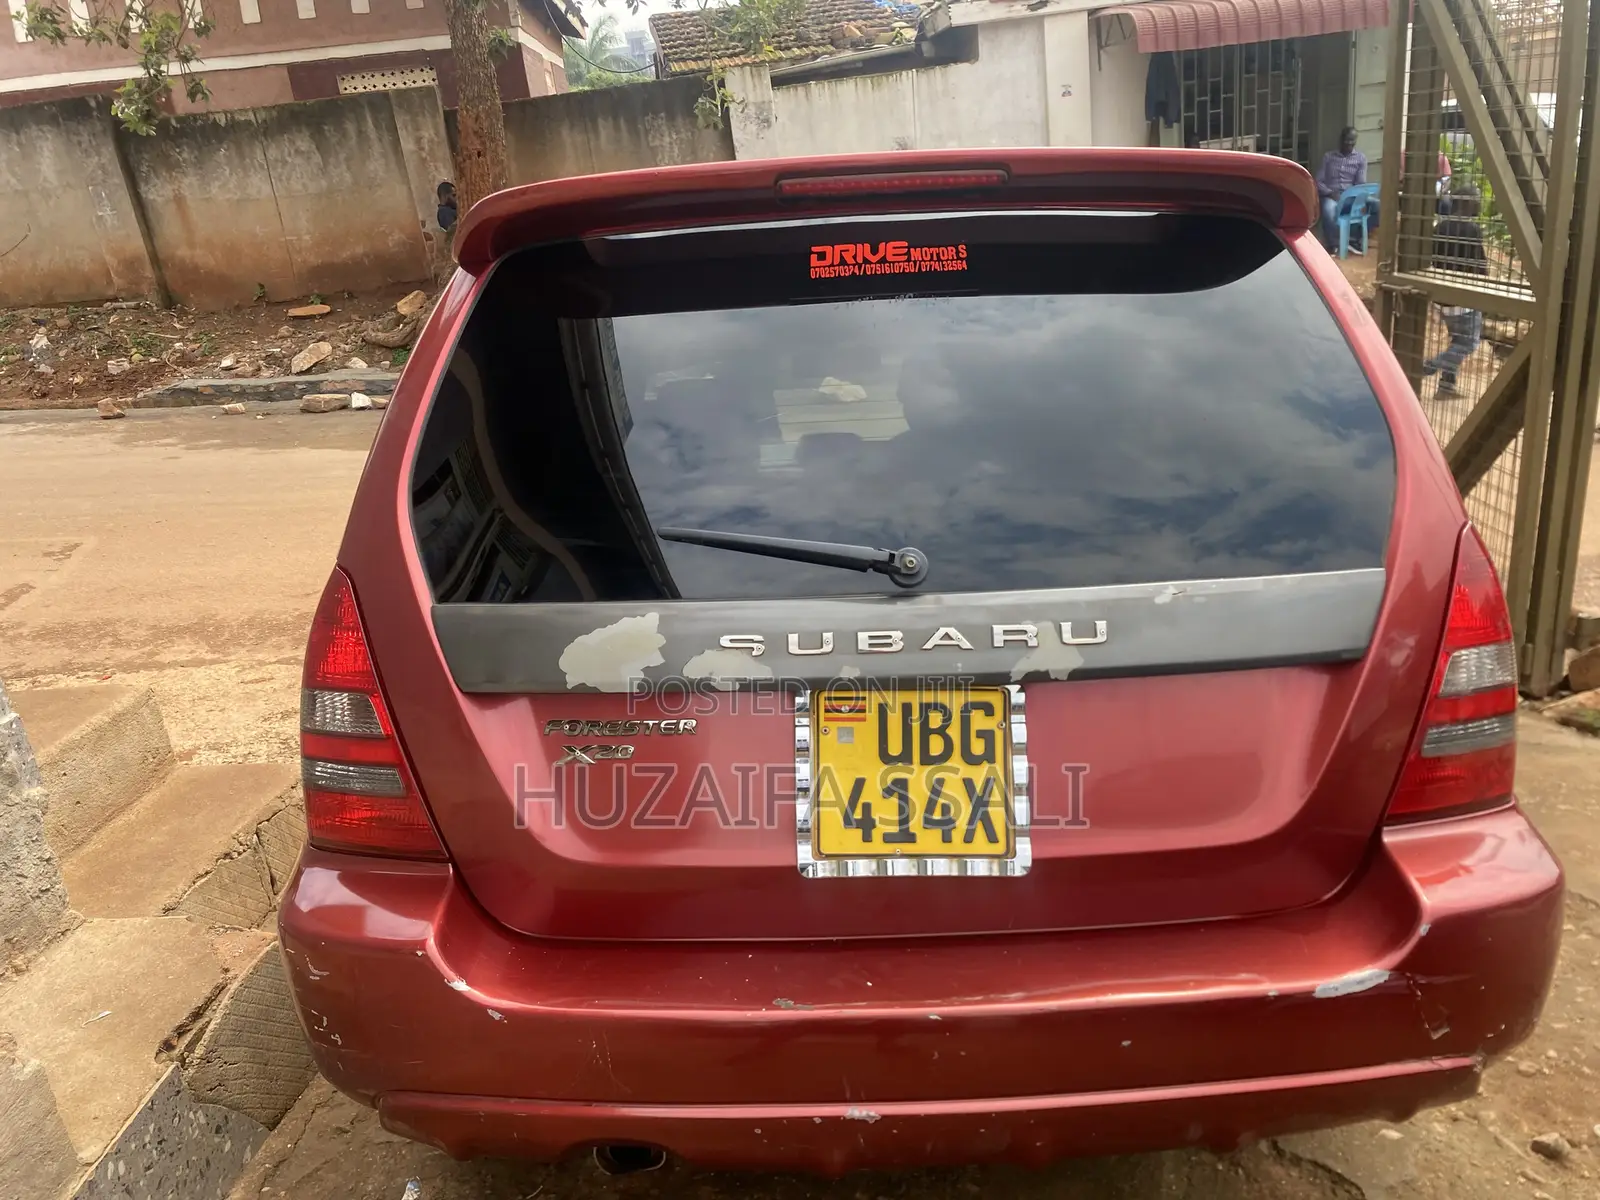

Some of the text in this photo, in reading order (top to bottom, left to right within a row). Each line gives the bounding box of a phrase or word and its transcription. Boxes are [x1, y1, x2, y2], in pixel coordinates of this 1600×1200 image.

[811, 241, 909, 267] DRIVE
[718, 619, 1108, 658] SUBARU
[543, 718, 698, 737] FORESTER
[878, 701, 996, 765] UBG
[555, 743, 635, 766] X20
[843, 777, 1000, 844] 414X
